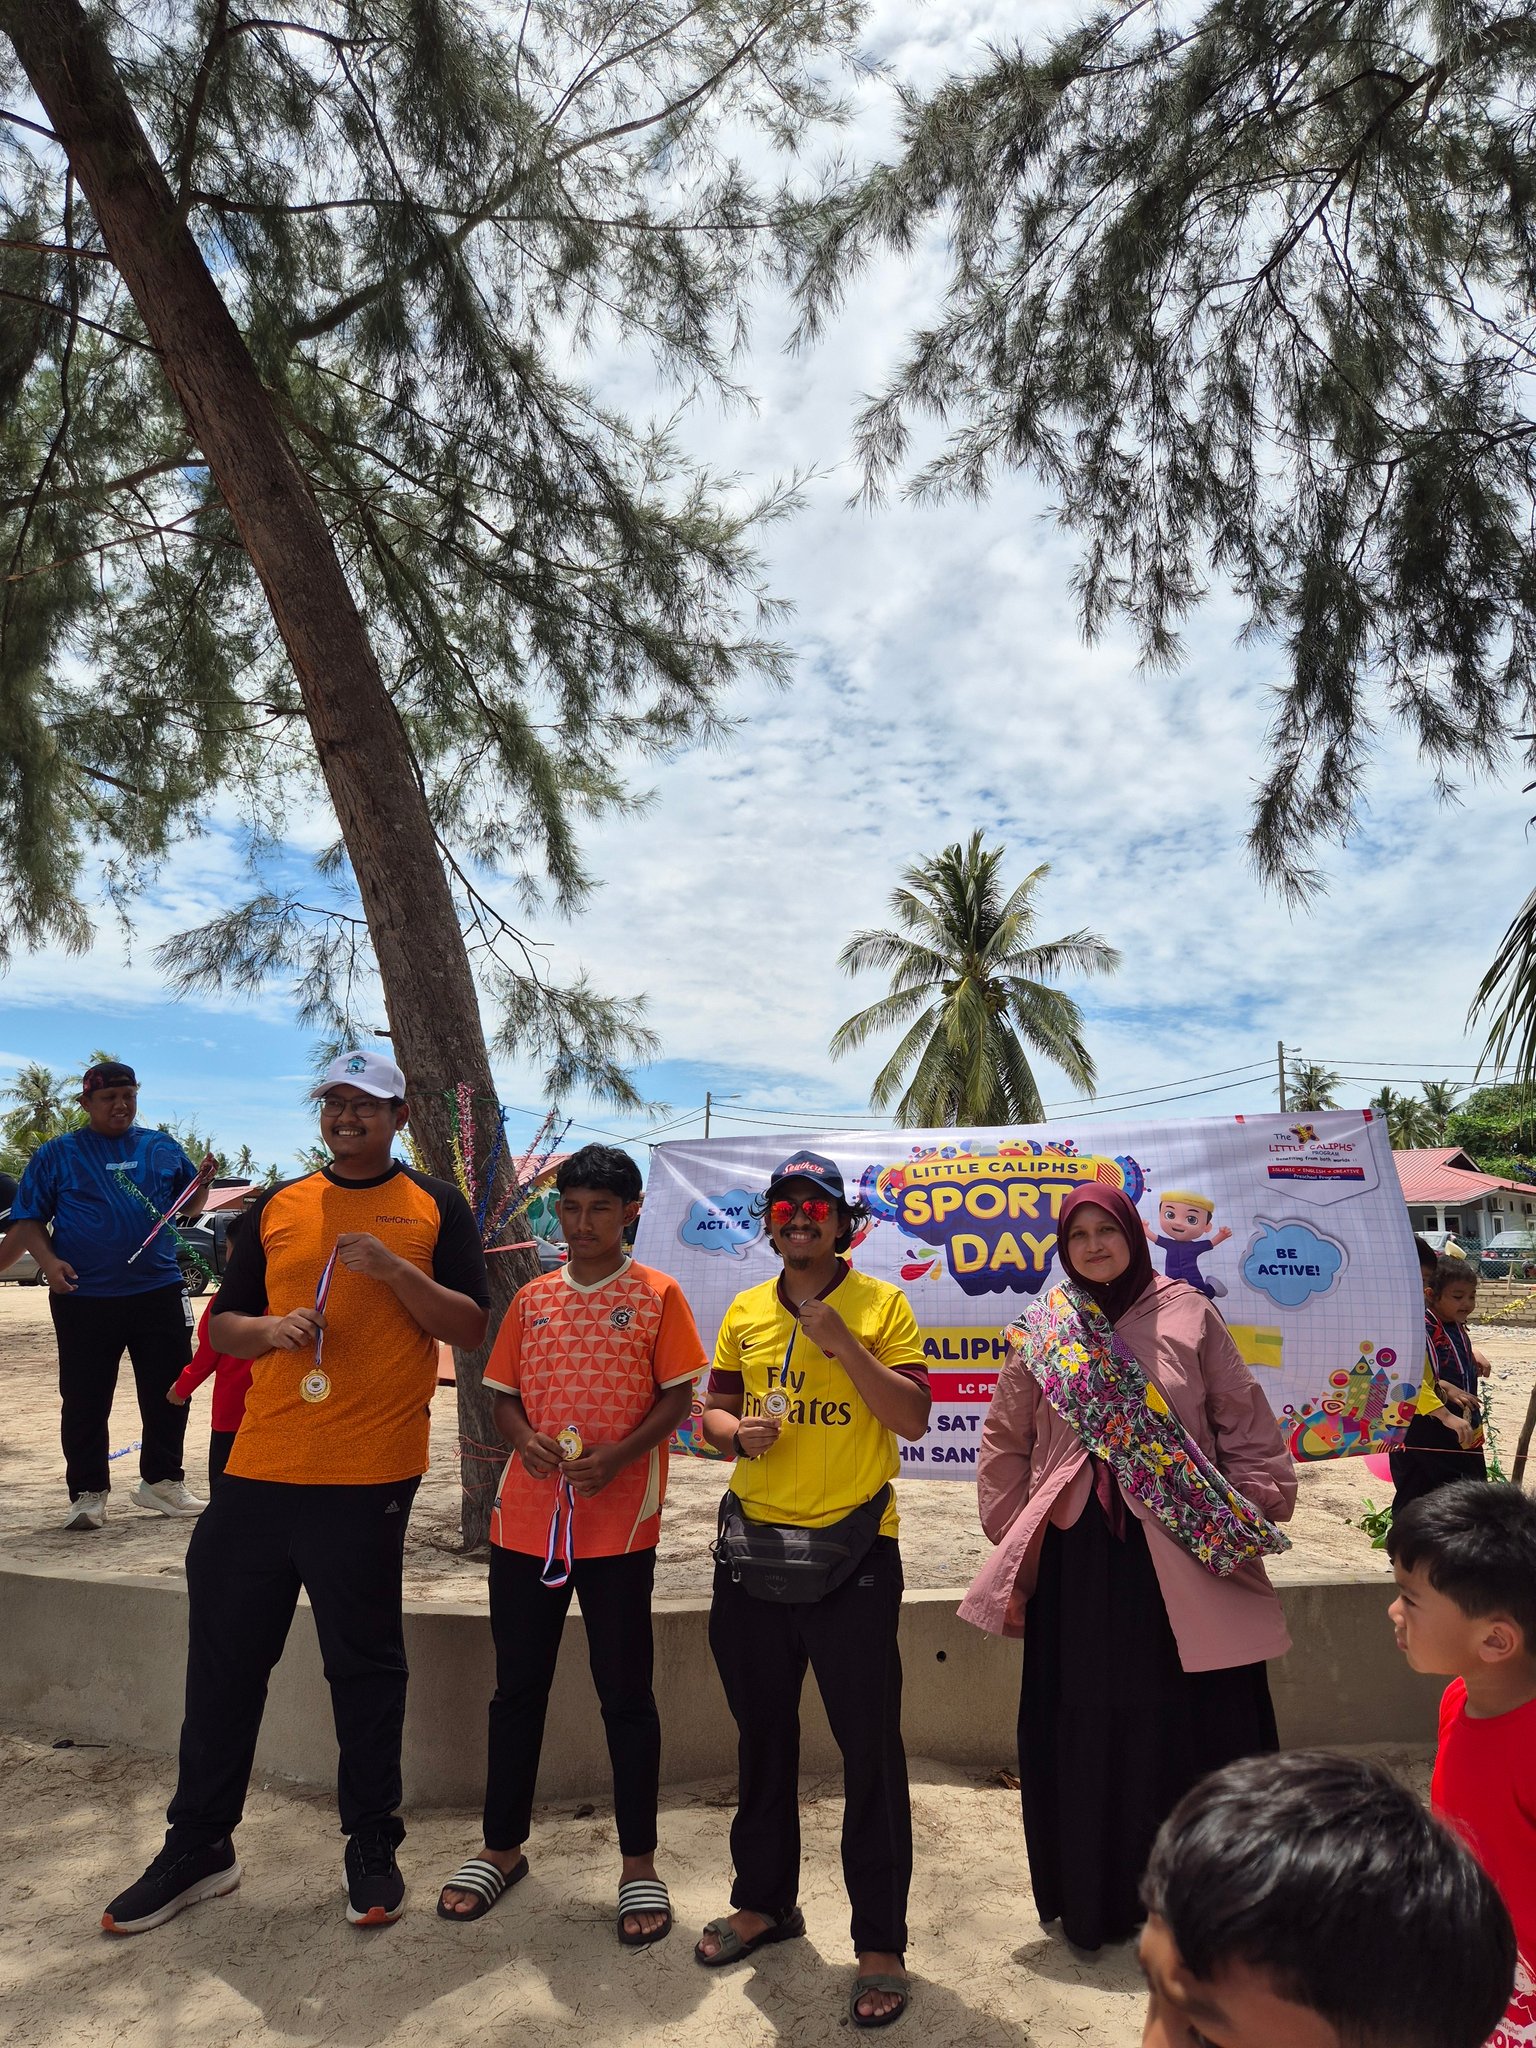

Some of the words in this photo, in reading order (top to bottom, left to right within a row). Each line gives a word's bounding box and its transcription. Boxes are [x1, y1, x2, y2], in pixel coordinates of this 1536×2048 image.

[1273, 1133, 1292, 1141] The
[1268, 1144, 1305, 1152] LITTLE
[782, 1161, 825, 1175] Southern
[912, 1162, 980, 1179] LITTLE
[903, 1183, 1075, 1226] SPORT
[707, 1206, 744, 1217] STAY
[696, 1219, 751, 1231] ACTIVE
[951, 1231, 1058, 1274] DAY
[1276, 1248, 1298, 1259] BE
[1258, 1263, 1320, 1276] ACTIVE!
[923, 1338, 1010, 1360] ALIPH
[958, 1383, 976, 1394] LC
[978, 1384, 996, 1394] PE
[937, 1415, 980, 1432] SAT
[899, 1446, 925, 1462] HN
[931, 1446, 980, 1463] SAN
